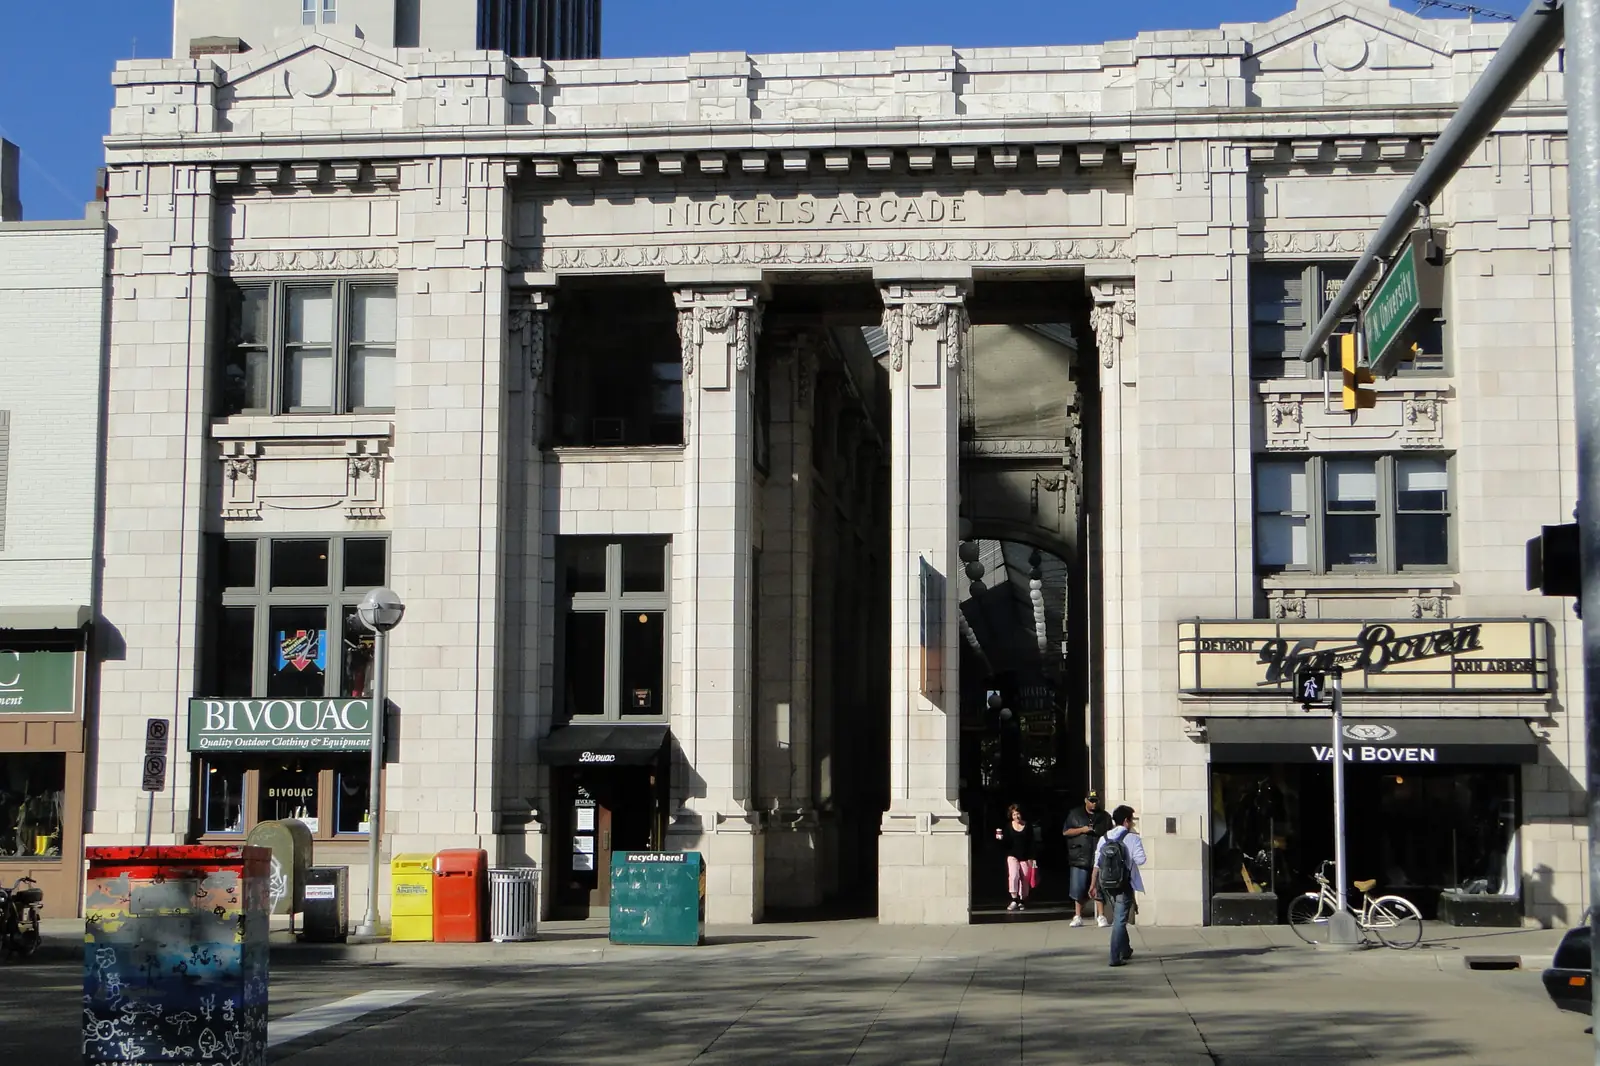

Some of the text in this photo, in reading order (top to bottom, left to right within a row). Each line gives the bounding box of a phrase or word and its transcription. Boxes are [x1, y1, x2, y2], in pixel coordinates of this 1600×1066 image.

[666, 198, 966, 226] NICKELS ARCADE
[1379, 270, 1413, 332] University
[1202, 639, 1255, 652] DETROIT
[1354, 624, 1482, 672] Boven
[1454, 660, 1483, 673] ANN
[202, 699, 369, 731] BIVOUAC
[200, 737, 371, 748] Quality Outdoor Clothing & Equipment
[579, 751, 616, 762] Bivouac
[1311, 746, 1435, 761] VAN BOVEN
[269, 788, 314, 798] BIVOUAC
[628, 853, 684, 863] recycle here!
